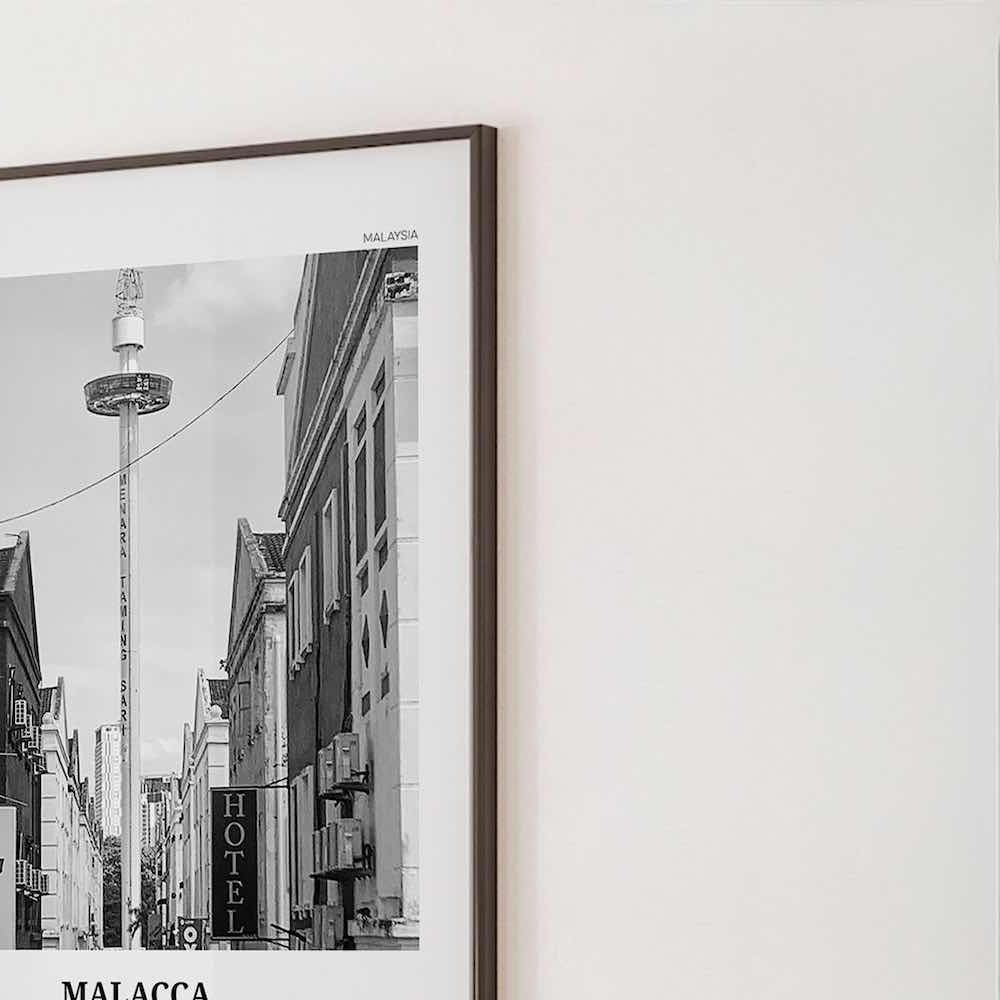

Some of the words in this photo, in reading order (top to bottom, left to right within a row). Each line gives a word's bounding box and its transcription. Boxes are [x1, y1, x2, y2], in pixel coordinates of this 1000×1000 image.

[363, 229, 418, 243] MALAYSIA
[119, 473, 127, 558] MENARA
[119, 576, 128, 661] TAMING
[119, 679, 128, 736] SARI
[223, 793, 247, 934] HOTEL
